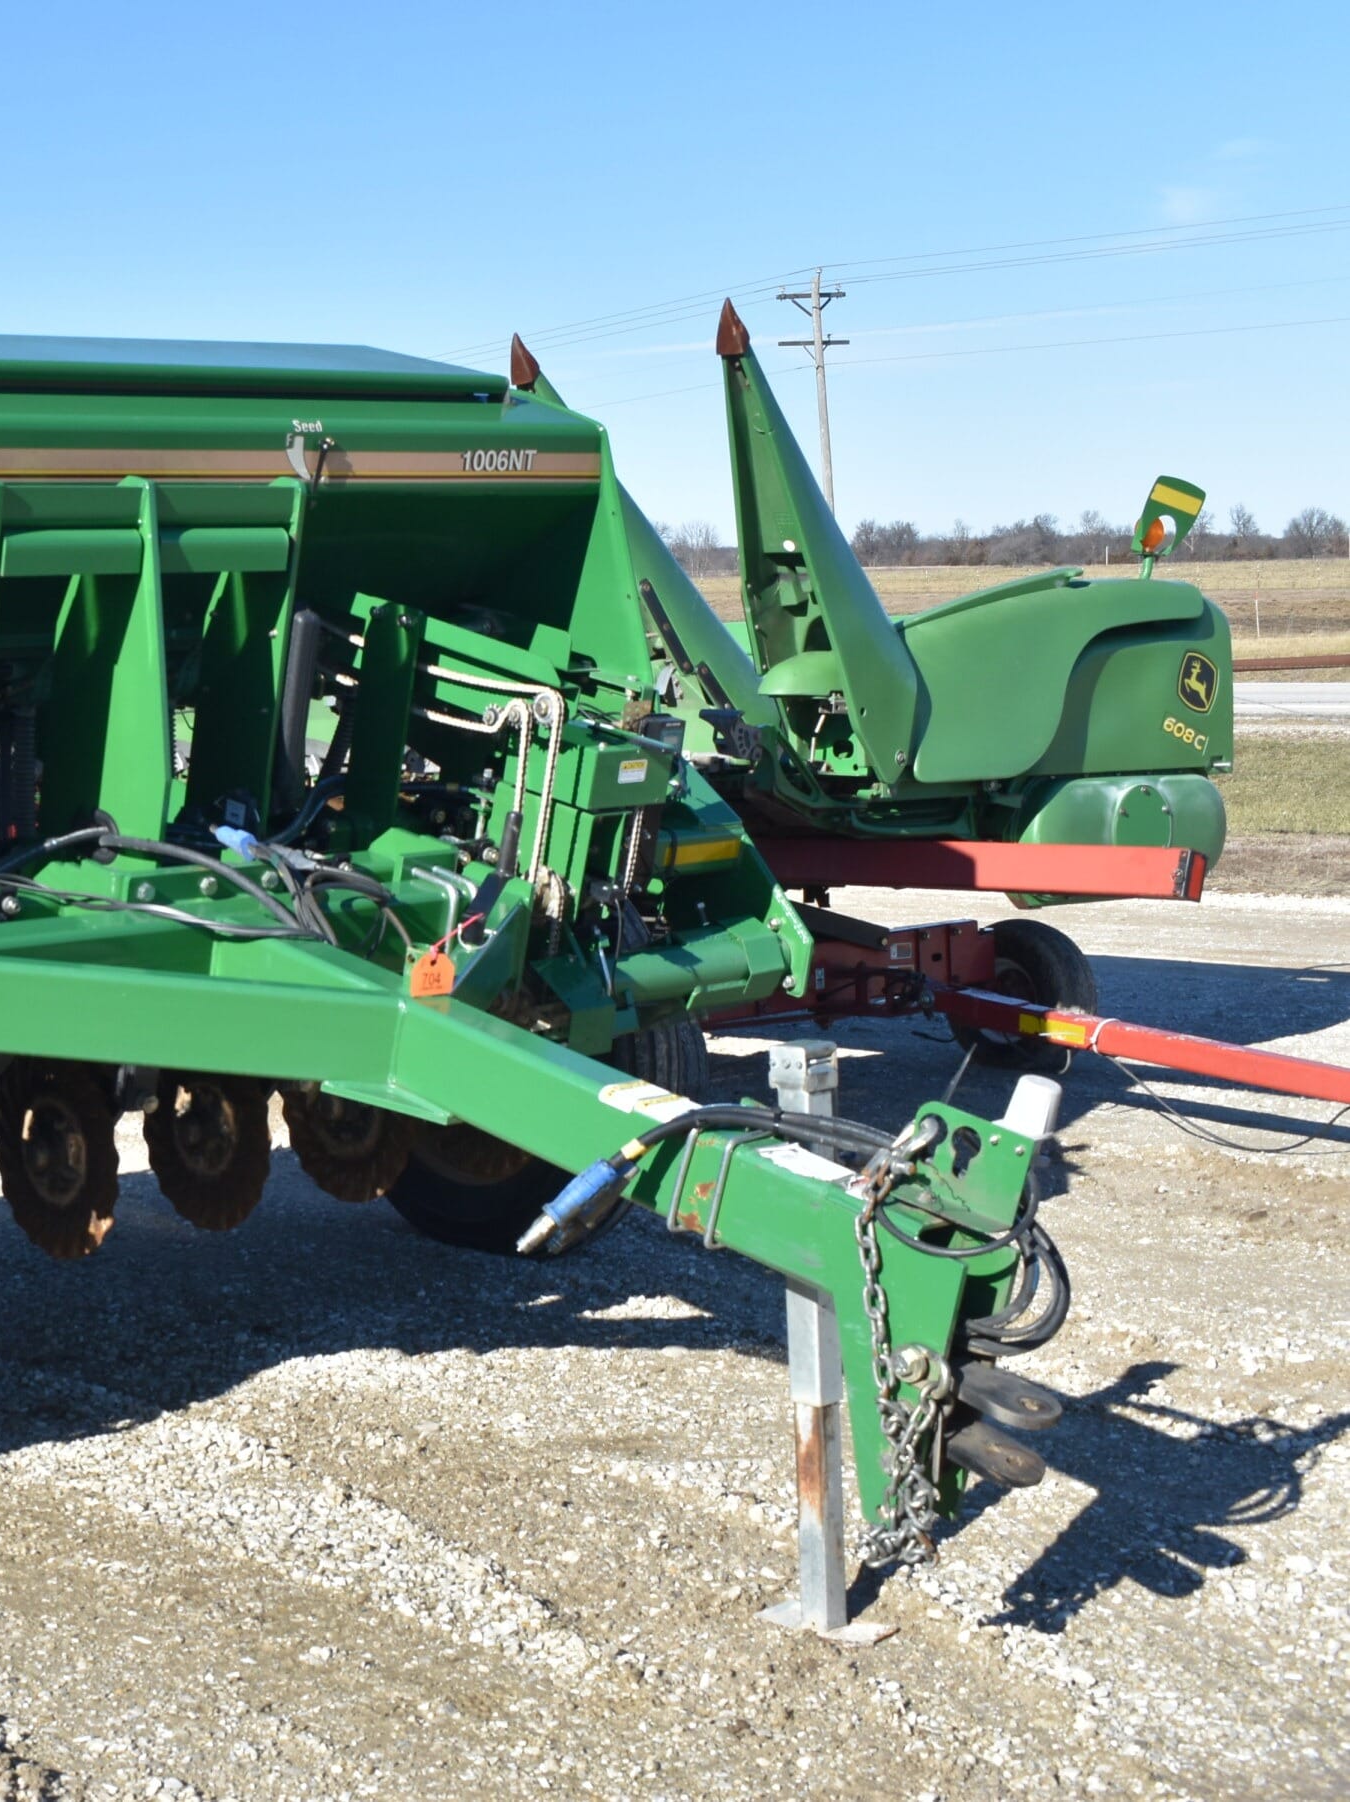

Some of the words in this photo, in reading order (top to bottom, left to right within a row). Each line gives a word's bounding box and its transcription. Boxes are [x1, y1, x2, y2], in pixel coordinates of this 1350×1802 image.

[291, 419, 323, 433] Seed
[462, 449, 537, 471] 1006NT
[1163, 716, 1206, 751] 608C
